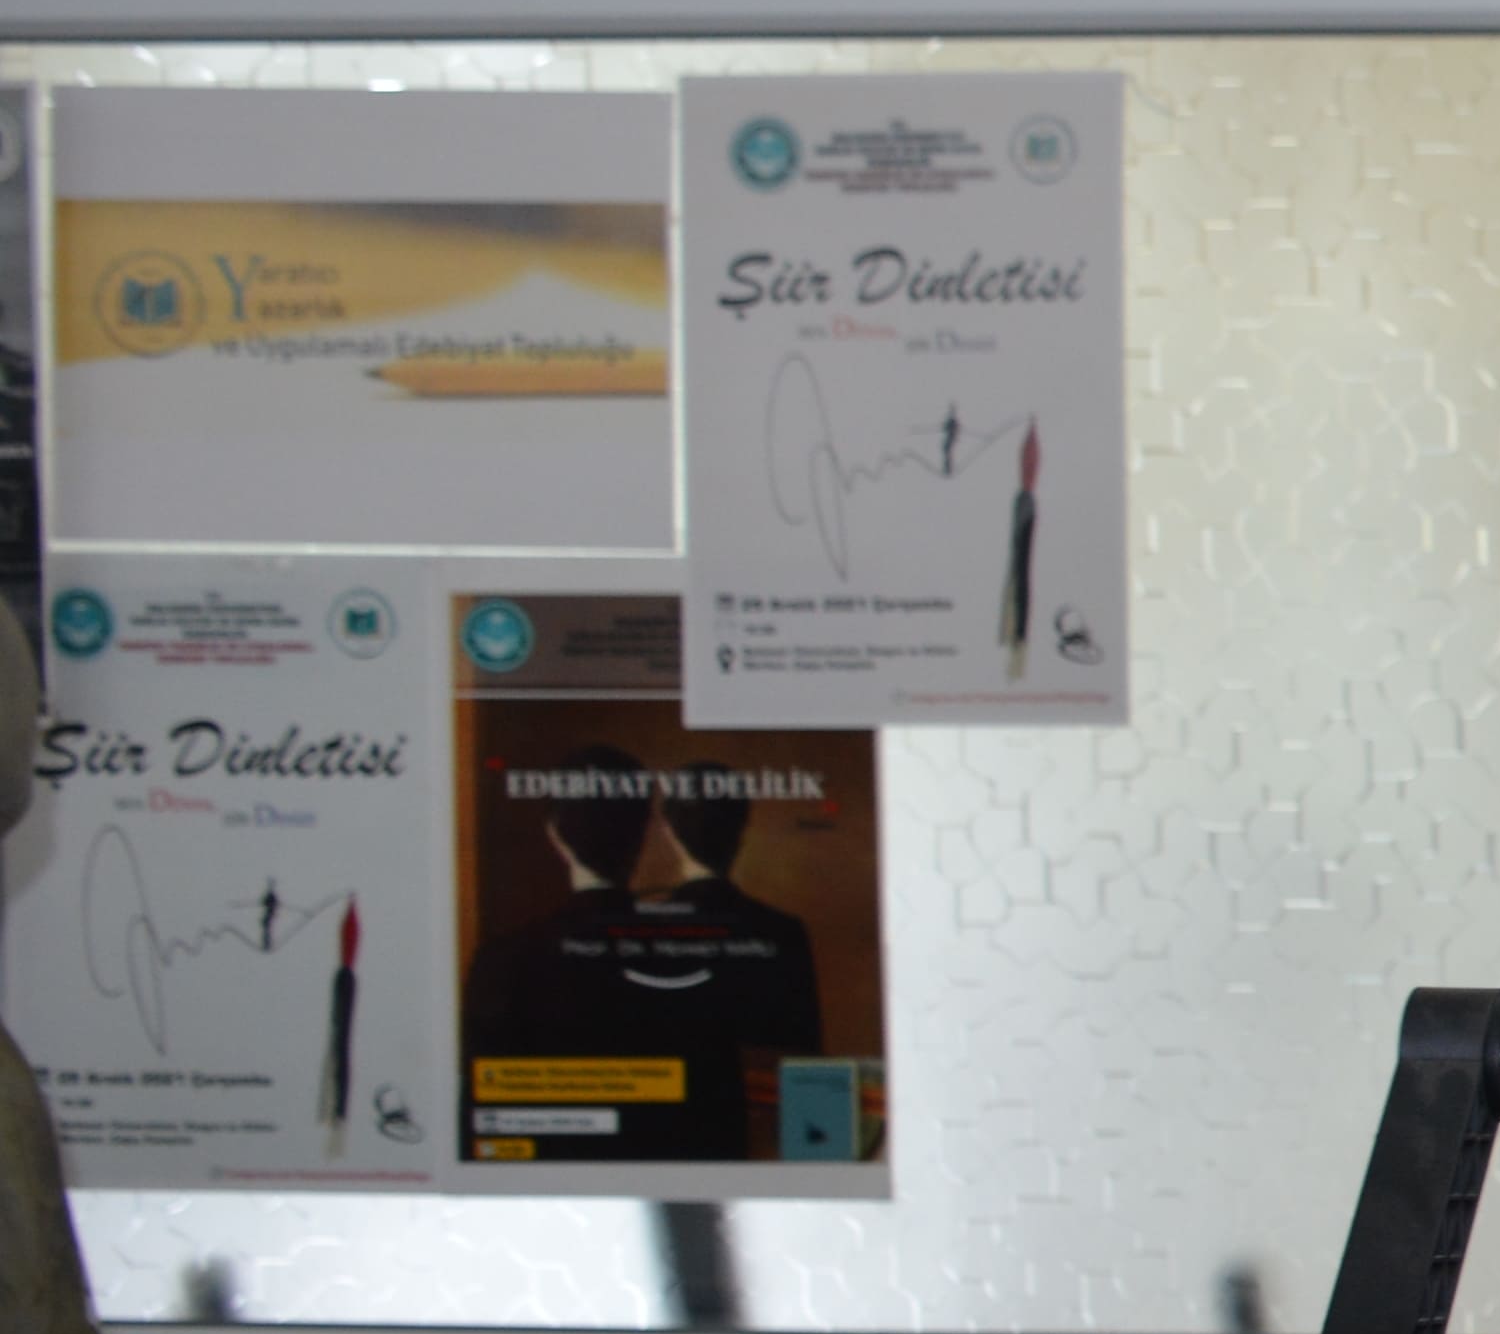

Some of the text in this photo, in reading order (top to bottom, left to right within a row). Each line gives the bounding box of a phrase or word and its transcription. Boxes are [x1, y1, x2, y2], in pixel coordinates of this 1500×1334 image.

[716, 246, 1088, 319] Şiir Dinletisi
[33, 719, 409, 791] Şiir Dinletisi
[506, 766, 653, 800] EDEBİYAT
[702, 765, 826, 800] DELİLİK
